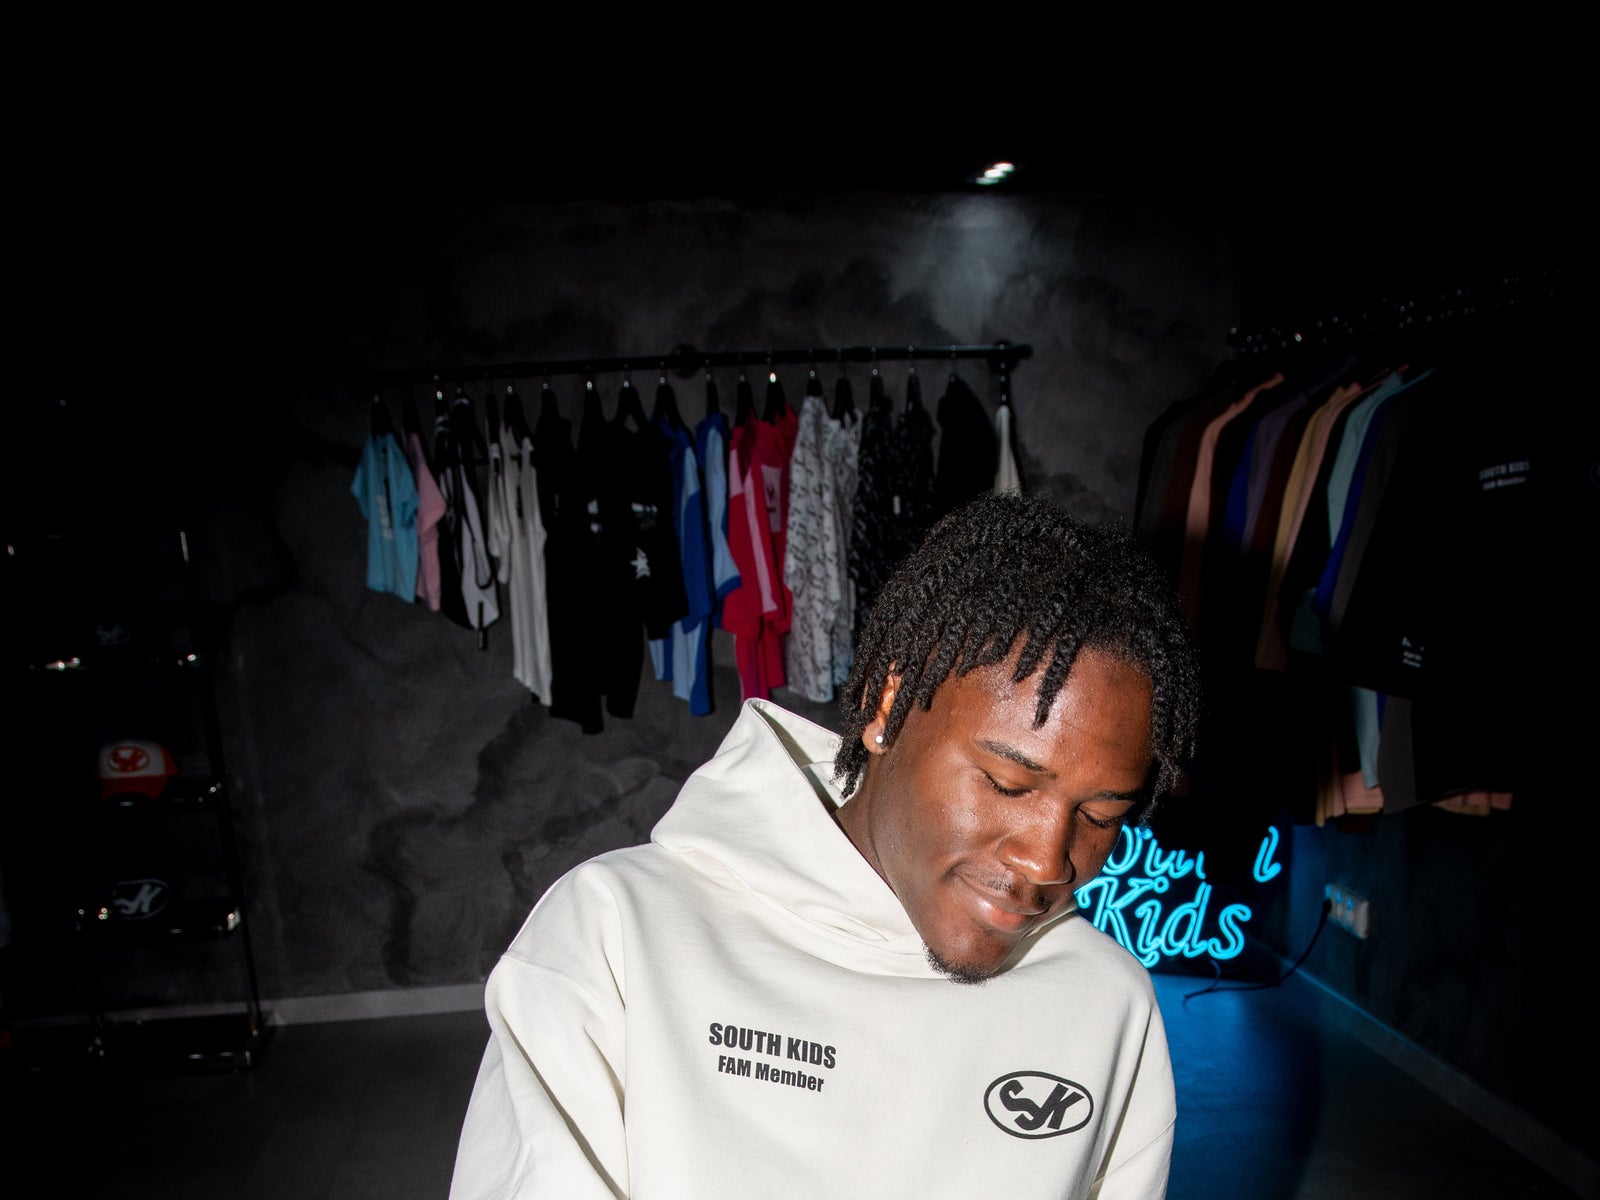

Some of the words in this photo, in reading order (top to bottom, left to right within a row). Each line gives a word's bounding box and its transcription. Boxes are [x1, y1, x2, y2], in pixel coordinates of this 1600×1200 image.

[1073, 876, 1252, 968] Kids
[708, 1022, 782, 1057] SOUTH
[786, 1036, 837, 1069] KIDS
[717, 1054, 752, 1078] FAM
[755, 1062, 824, 1093] Member
[999, 1079, 1085, 1131] SK
